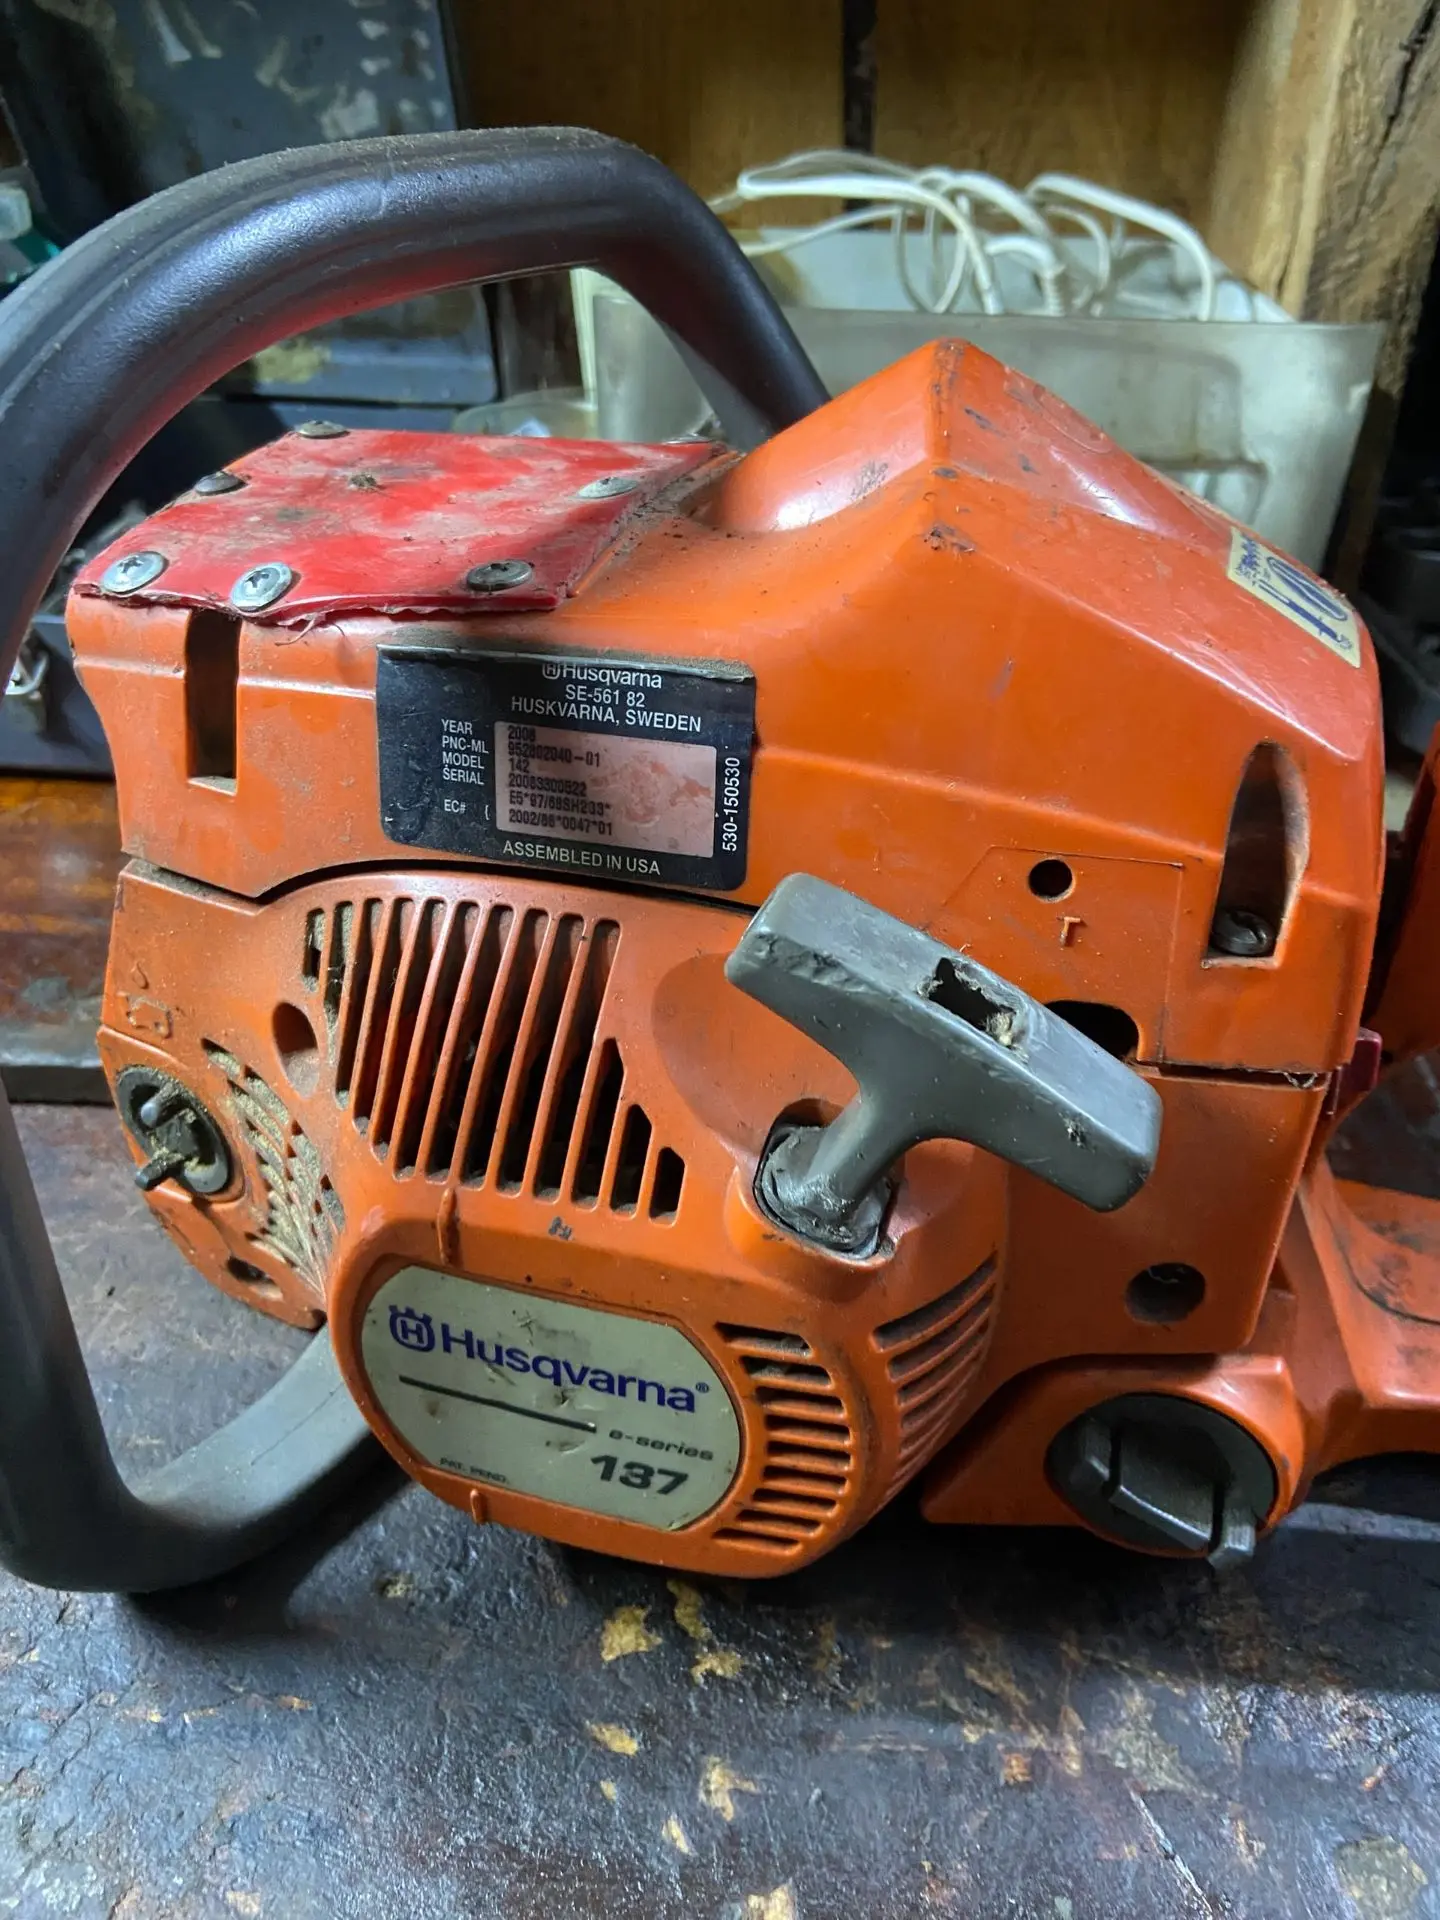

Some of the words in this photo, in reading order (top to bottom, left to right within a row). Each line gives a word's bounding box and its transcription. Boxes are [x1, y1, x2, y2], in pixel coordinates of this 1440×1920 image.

[562, 664, 663, 690] Husqvarna
[565, 684, 620, 705] SE-561
[626, 691, 646, 708] 82
[441, 718, 473, 736] YEAR
[511, 696, 620, 726] HUSKVARNA,
[625, 709, 702, 733] SWEDEN
[442, 735, 489, 754] PNC-ML
[442, 751, 485, 770] MODEL
[442, 767, 485, 786] SERIAL
[444, 799, 466, 815] EC#
[722, 756, 741, 852] 530-150530
[503, 839, 603, 867] ASSEMBLED
[606, 854, 622, 870] IN
[626, 856, 661, 876] USA
[608, 1429, 714, 1461] e-series
[590, 1454, 689, 1495] 137
